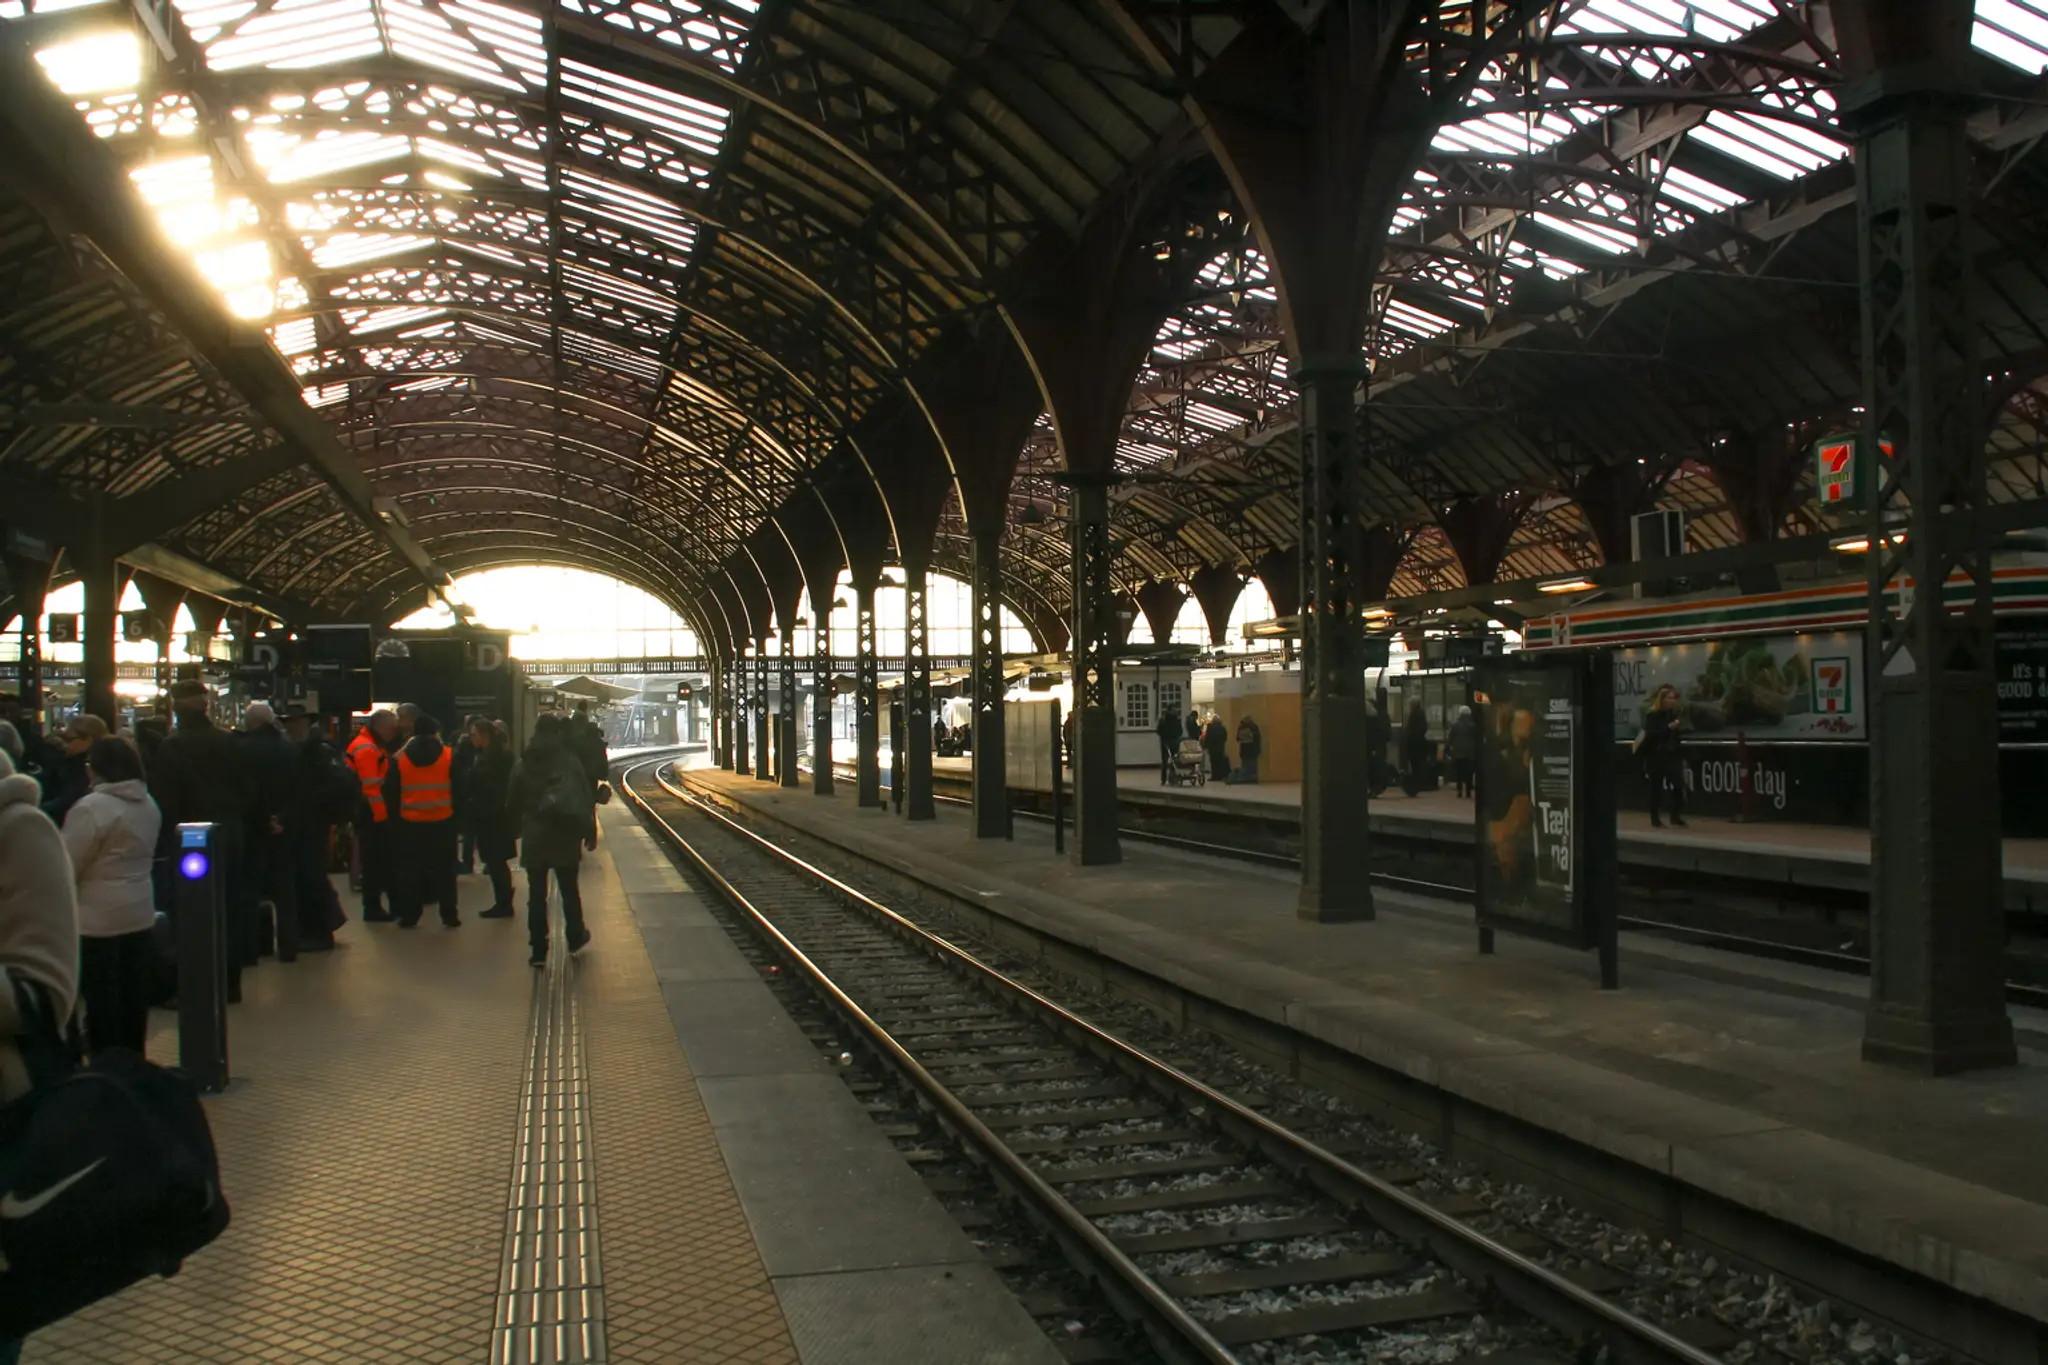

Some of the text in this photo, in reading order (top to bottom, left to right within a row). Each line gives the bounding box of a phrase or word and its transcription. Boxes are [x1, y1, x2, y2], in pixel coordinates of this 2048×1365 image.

[1821, 444, 1850, 501] 7
[56, 623, 68, 640] 5
[130, 620, 142, 636] 6
[253, 644, 279, 672] D
[477, 643, 503, 671] D
[1818, 666, 1842, 712] 7
[1997, 681, 2033, 699] GOOD
[1754, 762, 1787, 810] day
[1538, 801, 1569, 837] Tæt
